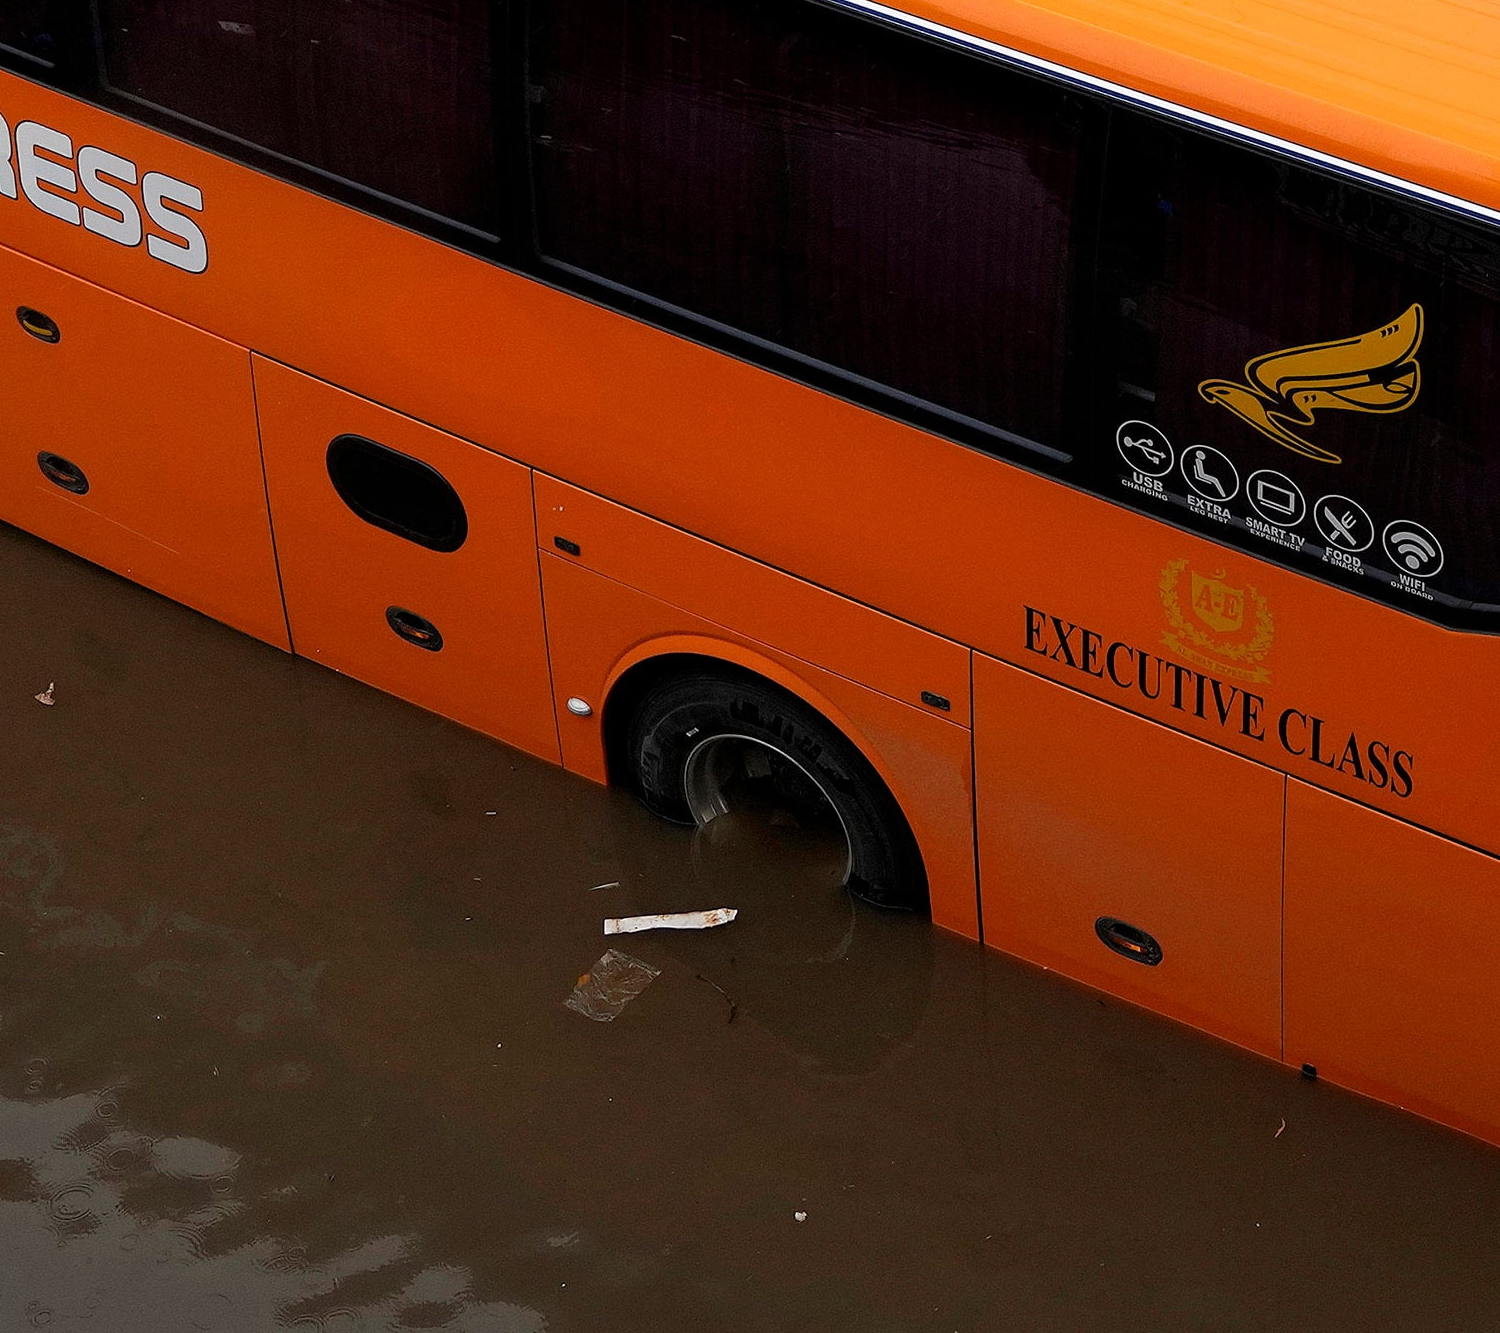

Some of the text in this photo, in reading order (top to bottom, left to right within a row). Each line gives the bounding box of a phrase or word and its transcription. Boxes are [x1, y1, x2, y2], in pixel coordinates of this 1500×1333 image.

[1121, 478, 1169, 502] CHARGING
[1132, 470, 1164, 493] USB
[1187, 494, 1232, 521] EXTRA
[1245, 517, 1306, 547] SMART TV
[1250, 528, 1302, 553] EXPERIENCE
[1324, 546, 1362, 569] FOOD
[1331, 556, 1366, 576] SNACKS
[1390, 580, 1435, 601] ON BOARD
[1399, 573, 1427, 593] WIFI
[1199, 578, 1241, 618] A-E
[1022, 605, 1415, 799] EXECUTIVE CLASS
